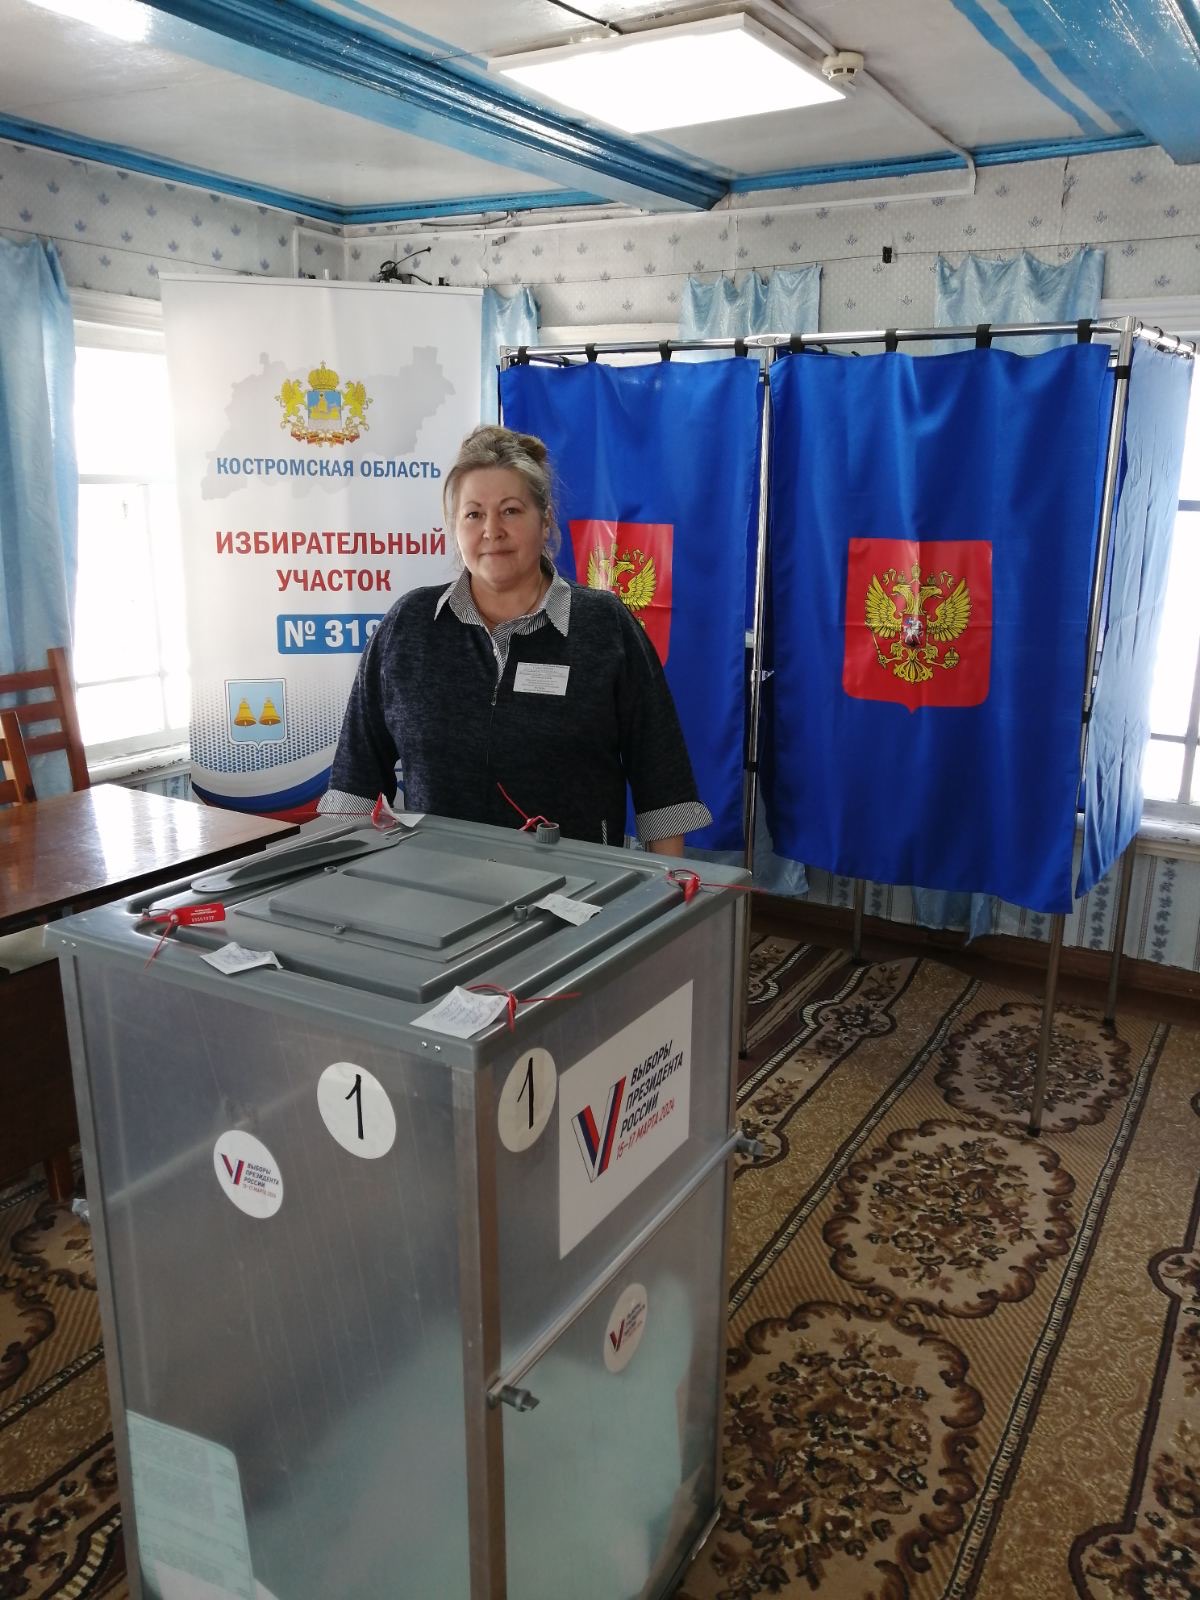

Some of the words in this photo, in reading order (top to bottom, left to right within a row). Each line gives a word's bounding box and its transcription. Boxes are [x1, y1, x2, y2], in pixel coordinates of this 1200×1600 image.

[216, 457, 354, 477] КОСТРОМСКАЯ
[360, 460, 442, 479] ОБЛАСТЬ
[215, 527, 446, 556] ИЗБИРАТЕЛЬНЫЙ
[276, 569, 392, 592] УЧАСТОК
[284, 620, 316, 648] №
[625, 1051, 684, 1113] ПРЕЗИДЕНТА
[631, 1041, 673, 1087] ВЫБОРЫ
[345, 1073, 364, 1140] 1
[516, 1057, 534, 1129] 1
[619, 1092, 660, 1139] РОССИИ
